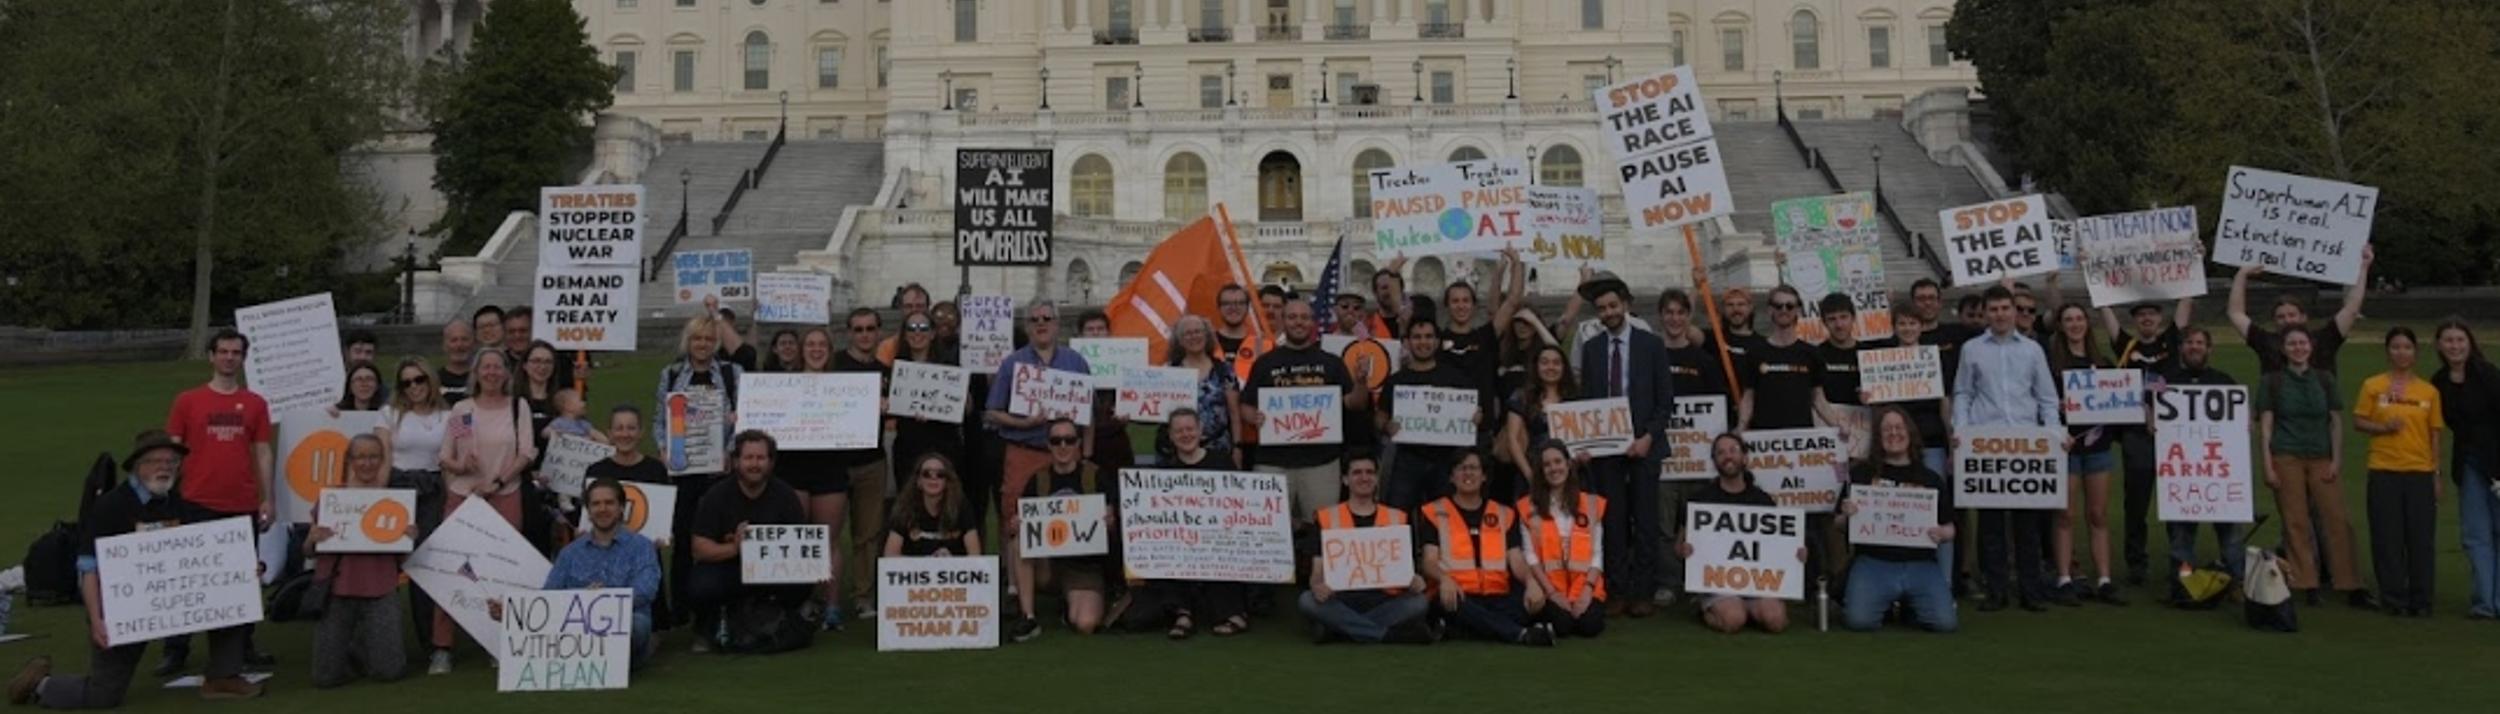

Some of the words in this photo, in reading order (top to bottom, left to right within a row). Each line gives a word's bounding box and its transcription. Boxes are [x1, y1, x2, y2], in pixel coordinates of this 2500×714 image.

[1608, 73, 1679, 108] STOP
[1608, 103, 1661, 131] THE
[1668, 93, 1695, 116] AI
[1622, 118, 1696, 152] RACE
[1620, 146, 1711, 183] PAUSE
[985, 169, 1024, 186] AI
[1660, 176, 1687, 199] AI
[2229, 170, 2331, 209] Superhuman
[2331, 192, 2371, 219] AI
[549, 192, 637, 209] TREATIES
[960, 188, 998, 206] WILL
[1005, 188, 1049, 206] MAKE
[1374, 194, 1446, 219] PAUSED
[1461, 186, 1527, 209] PAUSE
[549, 210, 636, 225] STOPPED
[971, 209, 996, 227] US
[1002, 209, 1038, 227] ALL
[1643, 192, 1712, 227] NOW
[1953, 200, 2029, 231] STOP
[2262, 206, 2280, 220] is
[548, 227, 634, 243] NUCLEAR
[1376, 225, 1442, 250] Nukes
[1476, 212, 1523, 237] AI
[1952, 228, 2006, 254] THE
[2015, 222, 2043, 244] AI
[2222, 218, 2306, 248] Extinction
[2312, 239, 2345, 256] risk
[568, 244, 614, 260] WAR
[958, 230, 1049, 262] POWERLESS
[1966, 249, 2042, 277] RACE
[2240, 245, 2253, 261] is
[2259, 250, 2287, 269] real
[2296, 256, 2327, 275] too
[542, 274, 624, 290] DEMAND
[2104, 267, 2134, 289] NOT
[556, 292, 584, 307] AN
[588, 292, 608, 307] AI
[545, 309, 619, 324] TREATY
[976, 319, 997, 332] AI
[556, 327, 605, 342] NOW
[1016, 365, 1046, 383] AI
[2067, 371, 2096, 390] AI
[1120, 390, 1138, 401] NO
[1267, 396, 1284, 411] AI
[1288, 393, 1335, 410] TREATY
[1395, 391, 1416, 401] NOT
[1424, 392, 1445, 402] TOO
[2156, 386, 2247, 422] STOP
[1138, 401, 1161, 416] AI
[1427, 404, 1442, 415] TO
[1684, 402, 1714, 415] LET
[1273, 409, 1323, 434] NOW
[1399, 416, 1477, 435] REGULATE
[1550, 409, 1607, 441] PAUSE
[1608, 406, 1634, 436] AI
[2173, 423, 2222, 440] THE
[1744, 436, 1836, 453] NUCLEAR:
[1971, 437, 2050, 455] SOULS
[1661, 460, 1707, 473] TURE
[1964, 457, 2058, 475] BEFORE
[2158, 462, 2231, 478] ARMS
[1123, 471, 1216, 495] Mitigating
[1222, 473, 1245, 491] the
[1252, 475, 1283, 493] risk
[1780, 475, 1806, 490] AI:
[1963, 477, 2058, 495] SILICON
[2167, 481, 2246, 503] RACE
[1022, 500, 1063, 518] PASE
[1122, 492, 1141, 509] of
[1150, 494, 1245, 510] EXTINCTION
[1263, 496, 1284, 514] AI
[2180, 505, 2217, 515] NOW
[1125, 511, 1180, 528] should
[1183, 511, 1203, 526] be
[1208, 516, 1219, 526] a
[1222, 512, 1275, 529] global
[1693, 510, 1797, 537] PAUSE
[743, 527, 788, 541] KEEP
[793, 527, 824, 540] THE
[1127, 526, 1200, 547] priority
[1859, 523, 1876, 537] AI
[105, 545, 129, 560] NO
[138, 533, 206, 555] HUMANS
[213, 528, 248, 545] WIN
[759, 545, 822, 560] FTRE
[1727, 540, 1761, 562] AI
[1325, 536, 1402, 571] PAUSE
[135, 561, 167, 576] THE
[179, 552, 225, 571] RACE
[886, 570, 930, 586] THIS
[937, 570, 990, 585] SIGN:
[1348, 564, 1389, 586] AI
[1703, 564, 1786, 592] NOW
[110, 583, 135, 599] TO
[143, 571, 251, 595] ARTIFICIAL
[150, 591, 207, 613] SUPER
[907, 587, 968, 603] MORE
[115, 603, 247, 637] INTELLIGENCE
[506, 596, 550, 633] NO
[559, 593, 632, 637] AGI
[885, 605, 989, 620] REGULATED
[895, 621, 952, 638] THAN
[957, 621, 979, 637] AI
[507, 633, 607, 660] WITHOUT
[516, 662, 537, 690] A
[547, 661, 608, 688] PLAN
